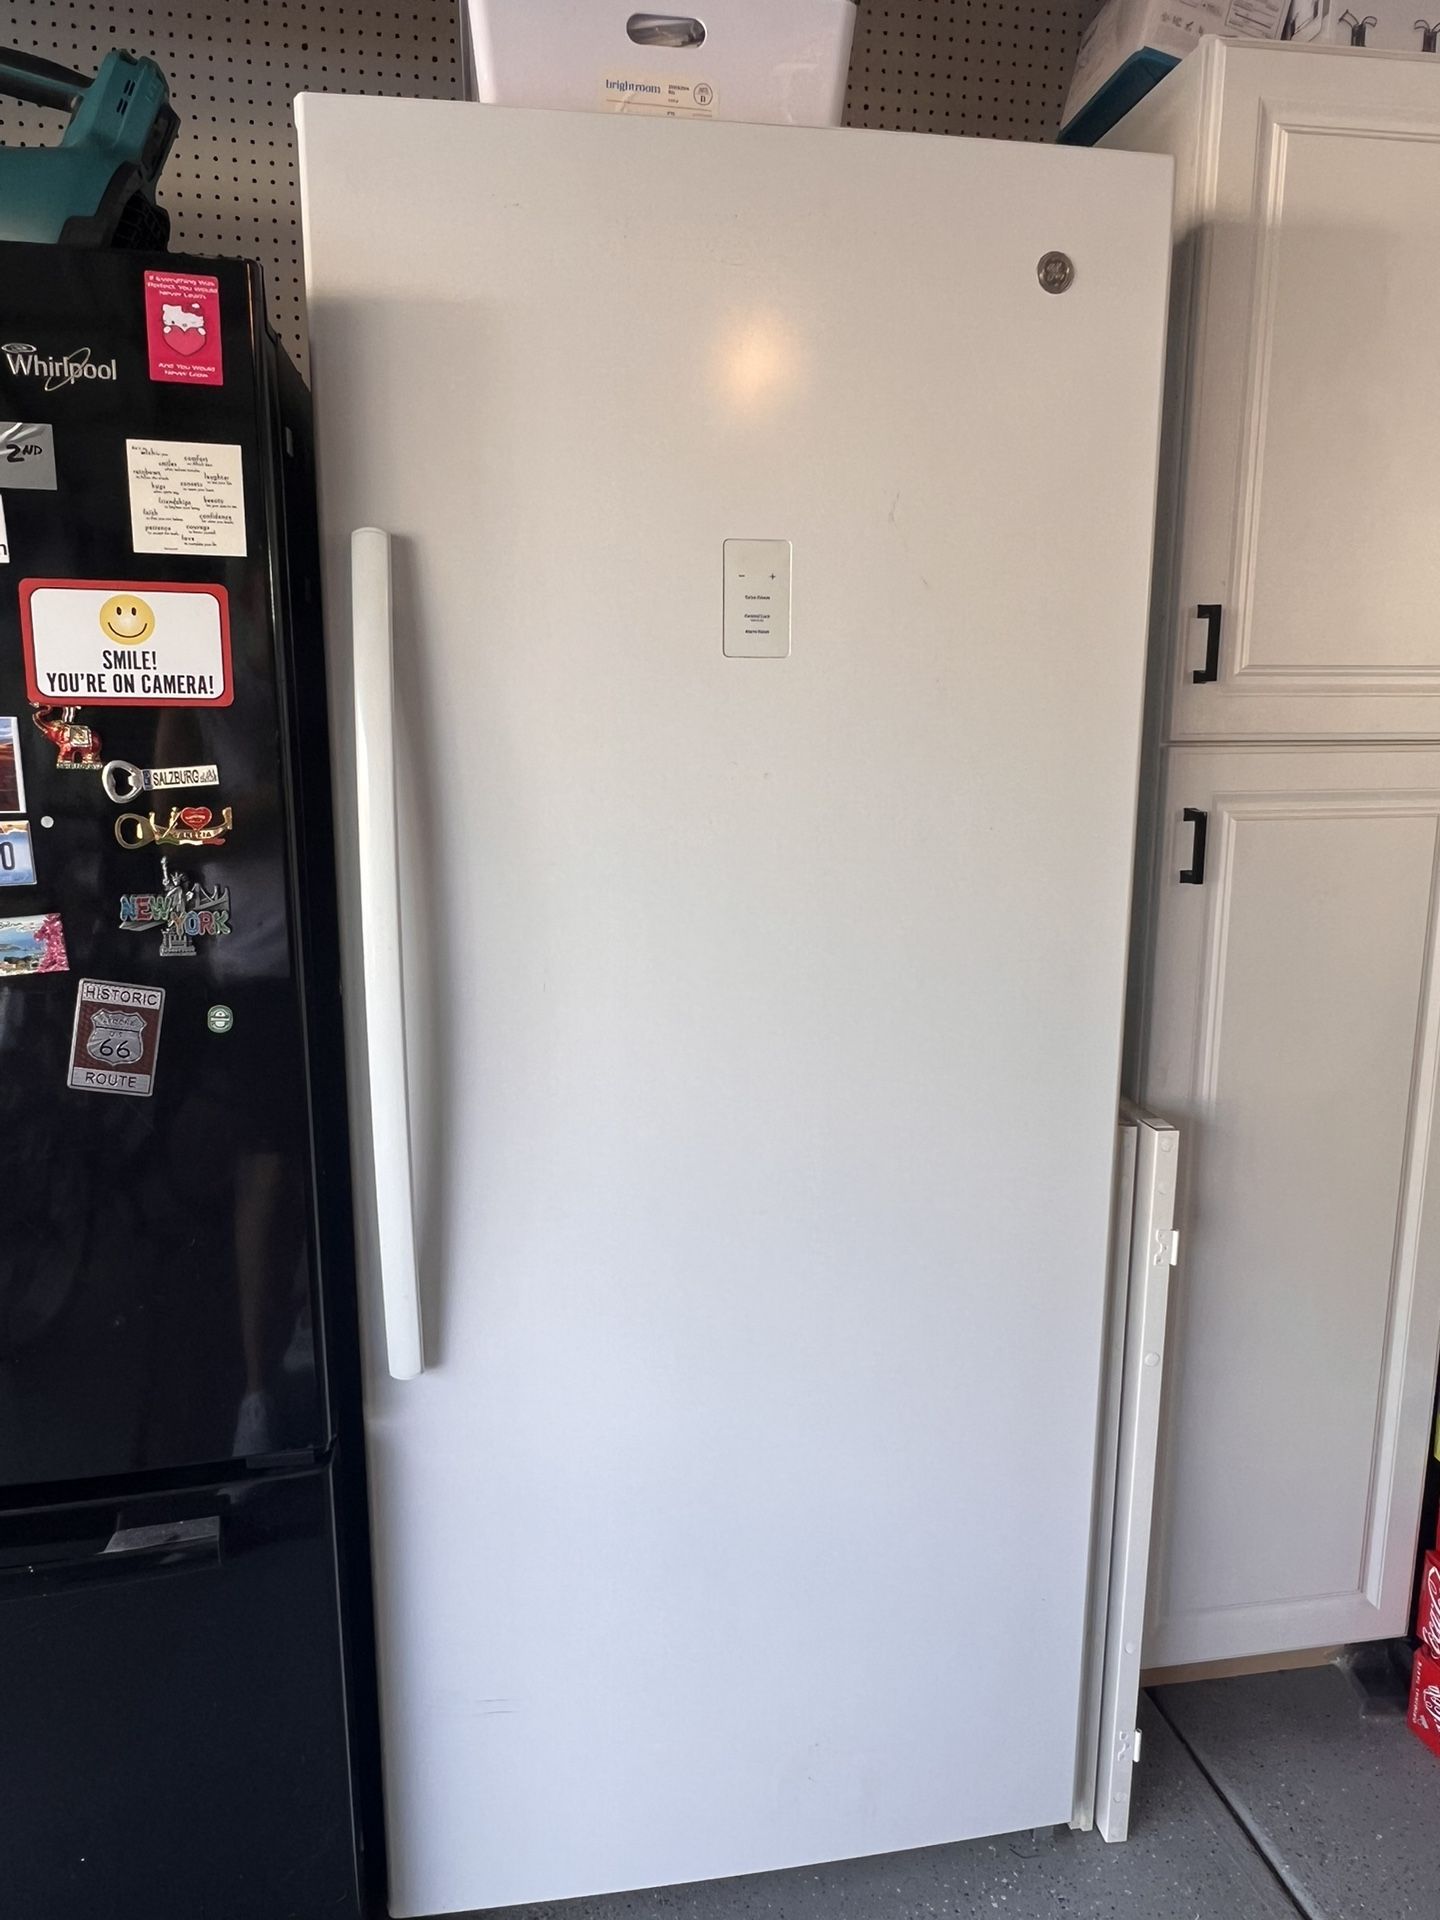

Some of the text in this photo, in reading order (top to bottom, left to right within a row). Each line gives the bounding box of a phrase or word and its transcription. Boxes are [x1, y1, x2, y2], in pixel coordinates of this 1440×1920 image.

[605, 79, 661, 94] brightroom
[5, 351, 117, 387] Whirlpool
[102, 649, 158, 671] SMILE!
[46, 672, 215, 695] YOU'RE ON CAMERA!
[152, 769, 200, 786] SALZBURG
[120, 895, 172, 922] NEW
[170, 910, 231, 936] YORK
[85, 984, 158, 1007] HISTORIC
[99, 1038, 131, 1059] 66
[85, 1071, 138, 1089] ROUTE
